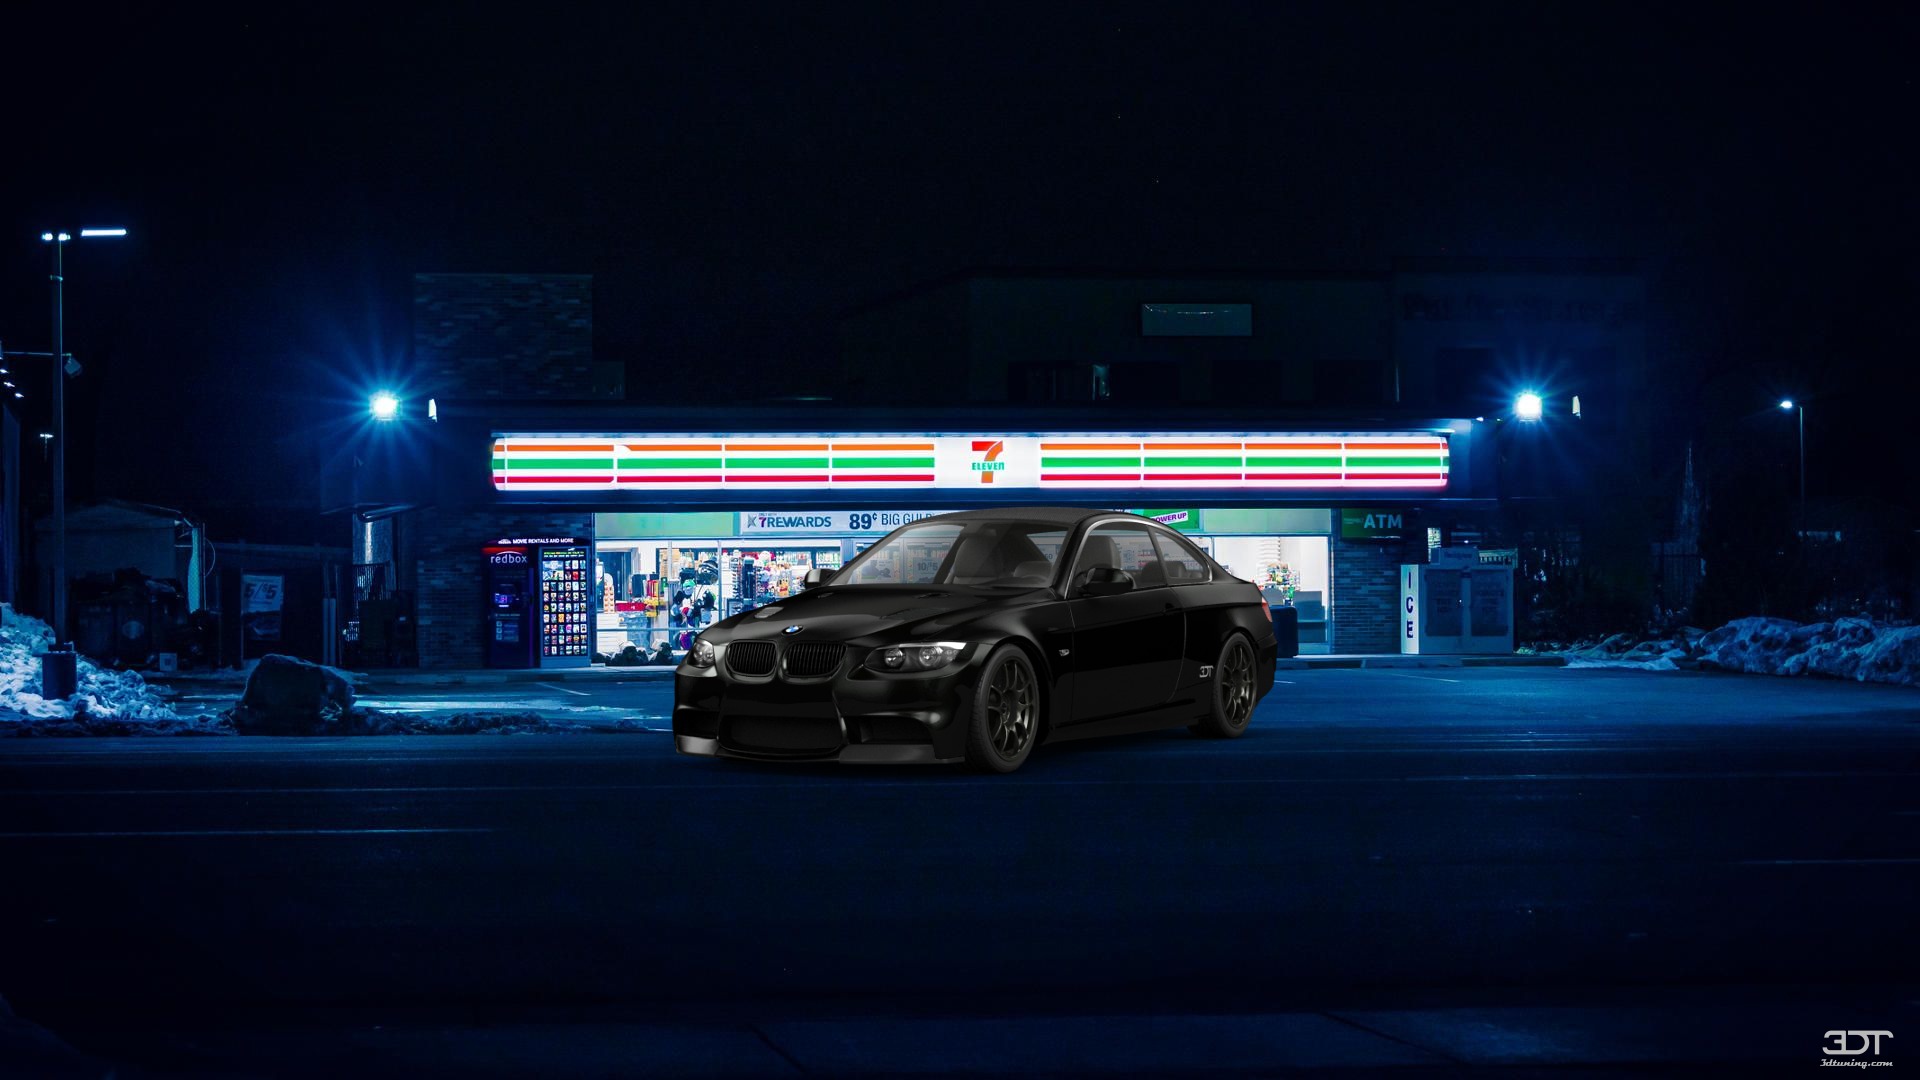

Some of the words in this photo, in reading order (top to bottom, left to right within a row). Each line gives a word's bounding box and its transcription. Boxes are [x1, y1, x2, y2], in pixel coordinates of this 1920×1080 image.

[972, 440, 1003, 483] 7
[881, 513, 900, 526] BIG
[1152, 514, 1177, 522] OWER
[1178, 512, 1187, 520] UP
[1364, 513, 1403, 529] ATM
[490, 553, 527, 564] redbox
